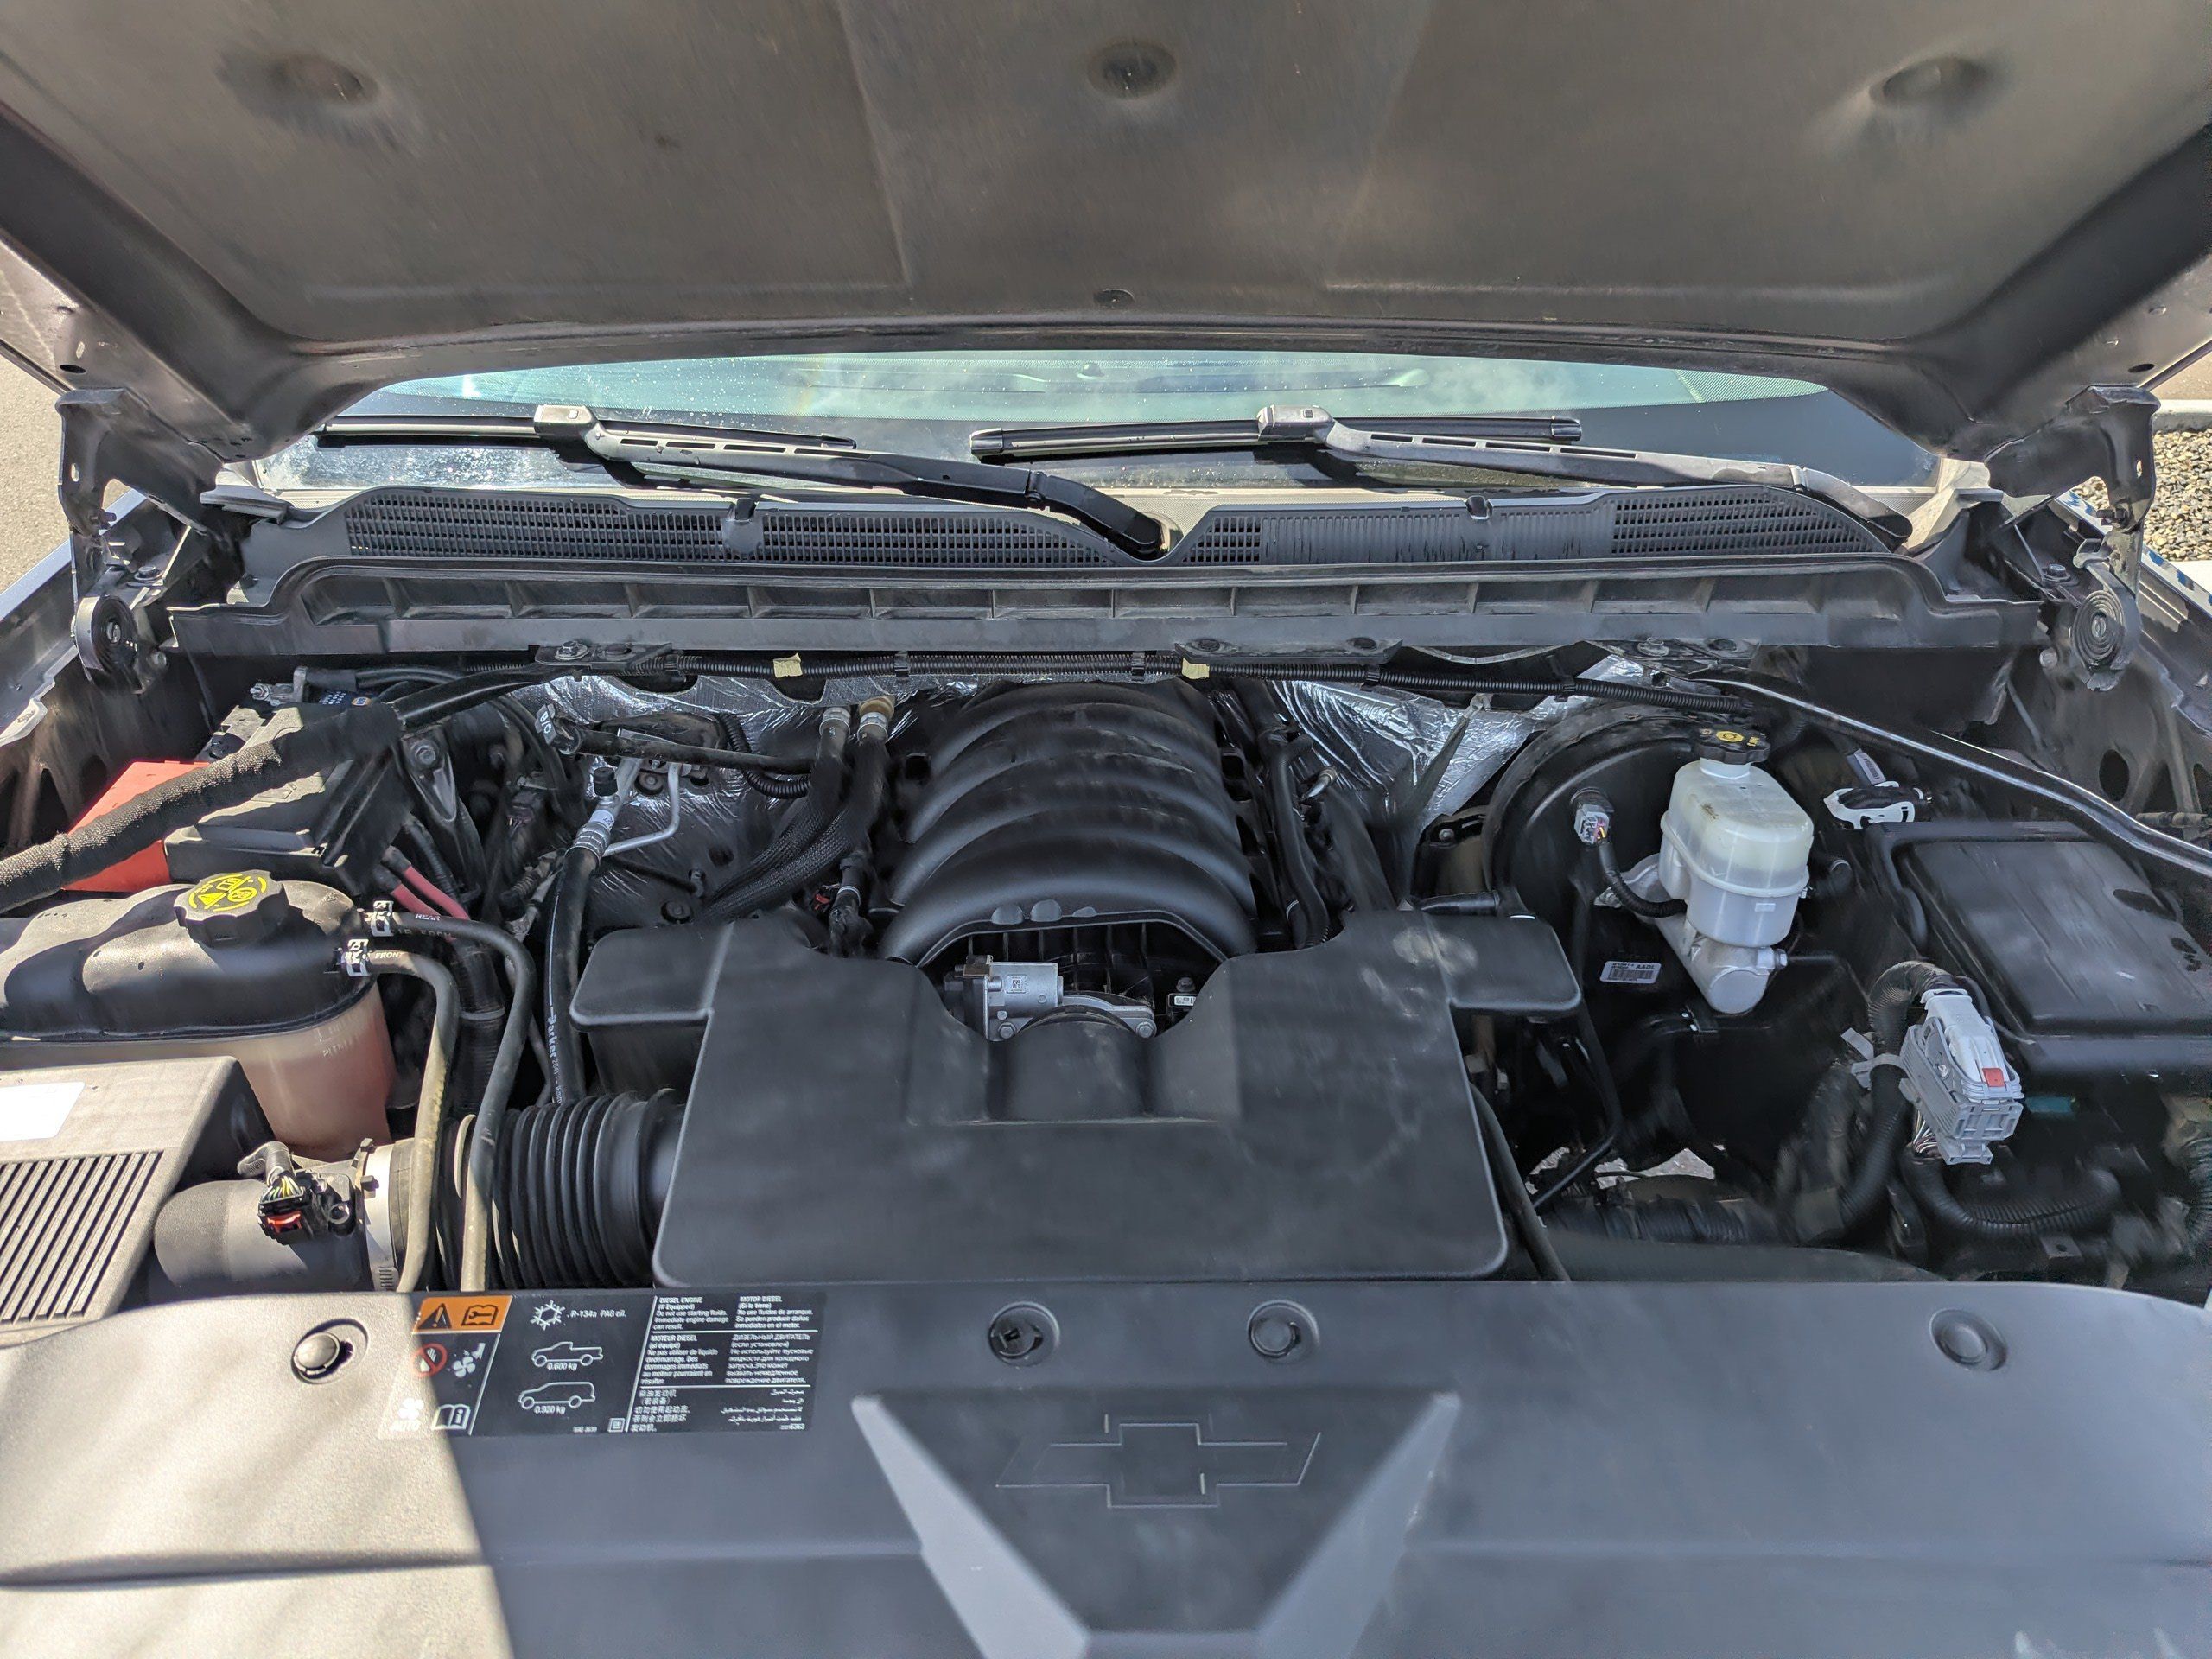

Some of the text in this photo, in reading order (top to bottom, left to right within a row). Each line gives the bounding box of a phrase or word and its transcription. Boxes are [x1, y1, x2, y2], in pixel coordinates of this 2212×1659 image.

[547, 1014, 557, 1058] Parker
[568, 1363, 578, 1371] kg
[556, 1406, 566, 1414] kg
